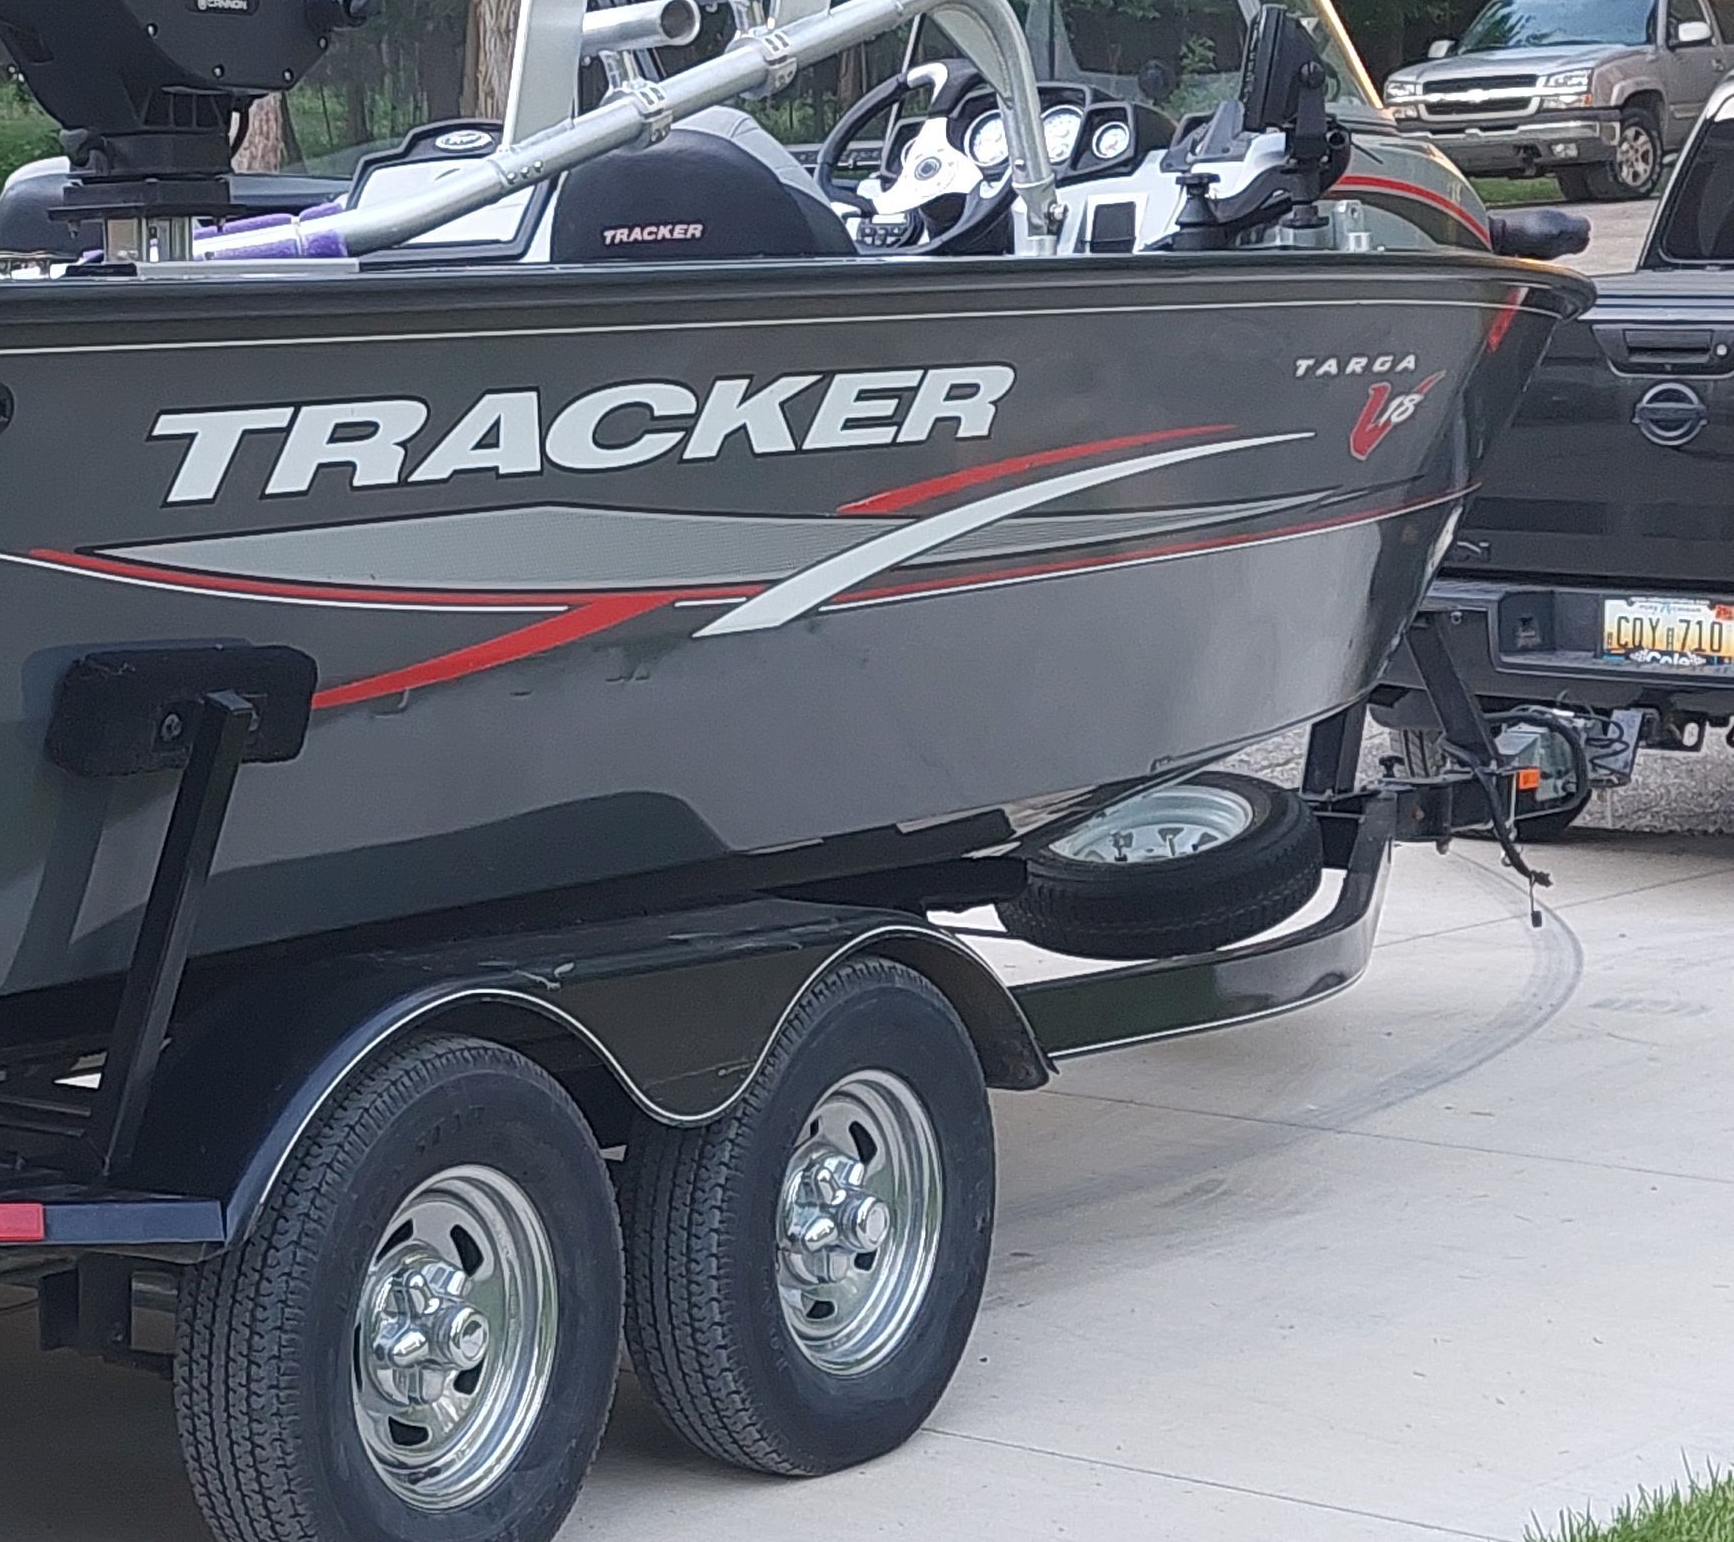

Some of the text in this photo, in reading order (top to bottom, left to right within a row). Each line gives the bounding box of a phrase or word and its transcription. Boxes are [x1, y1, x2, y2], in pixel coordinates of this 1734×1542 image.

[602, 222, 704, 246] TRACKER
[1295, 354, 1416, 377] TARGA
[149, 365, 1015, 505] TRACKER
[1679, 619, 1723, 653] 710
